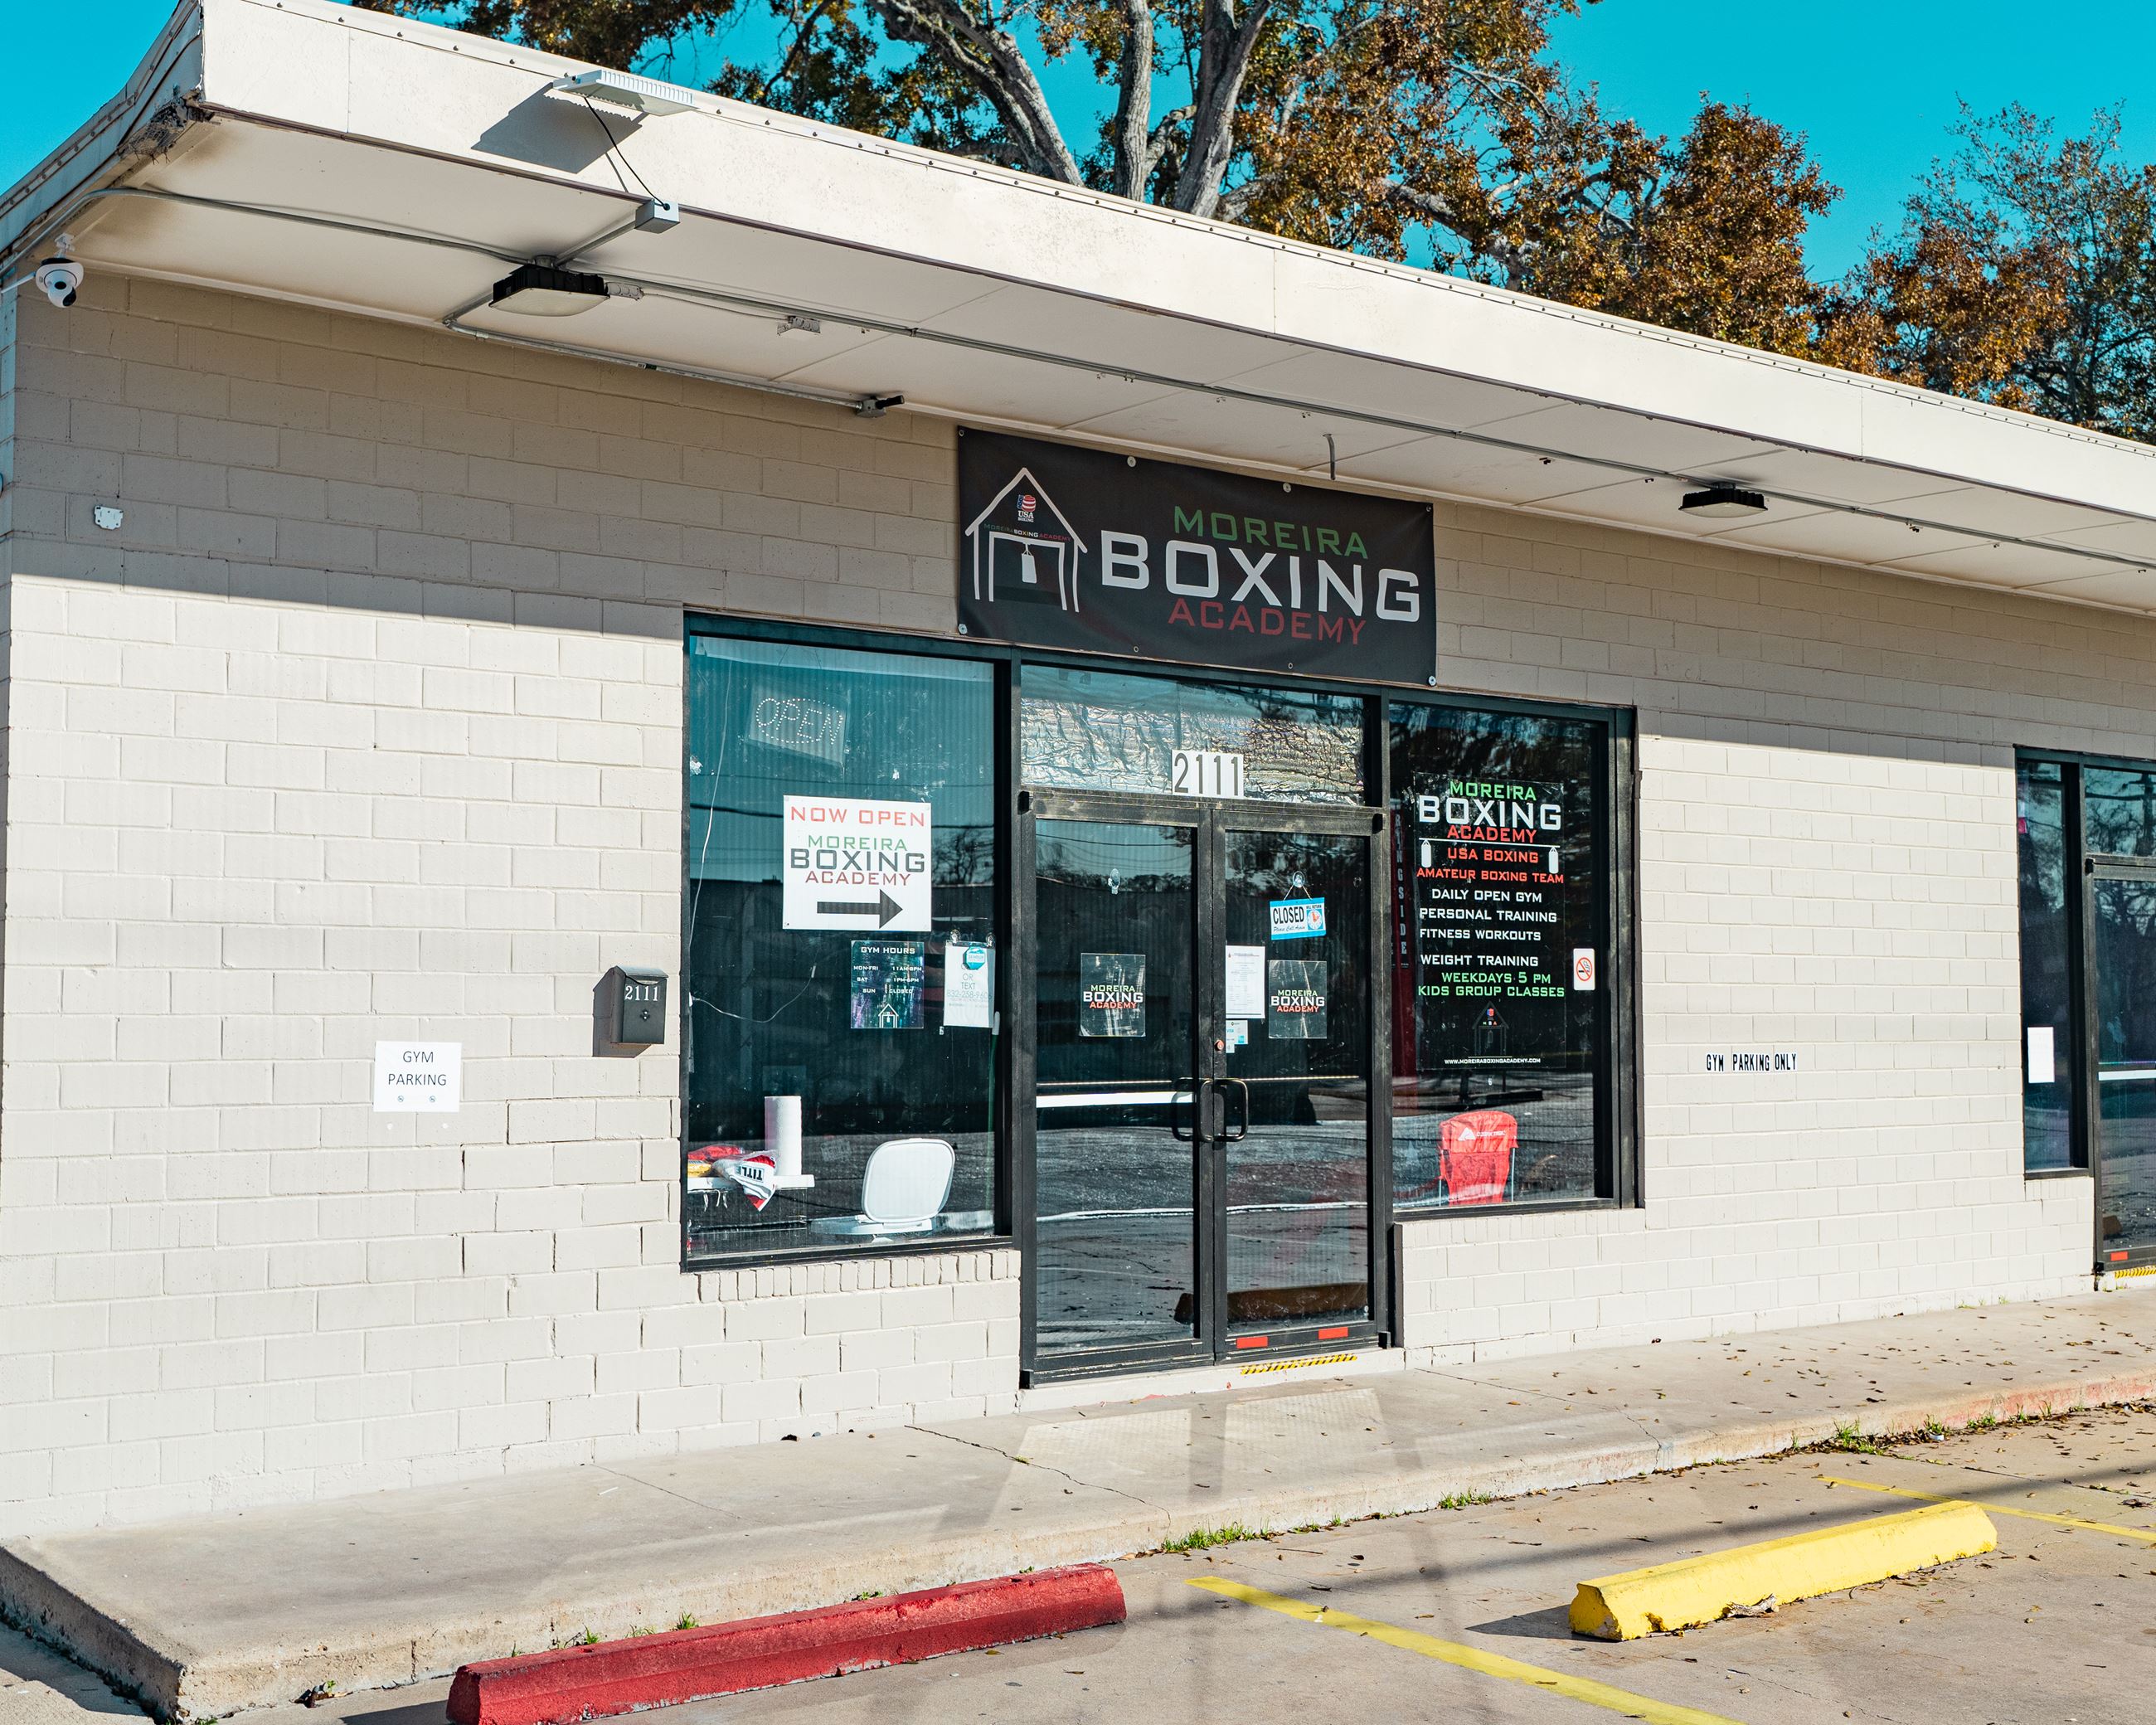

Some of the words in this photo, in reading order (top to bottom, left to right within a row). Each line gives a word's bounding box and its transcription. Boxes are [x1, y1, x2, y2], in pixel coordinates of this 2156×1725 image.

[1017, 510, 1034, 519] USA
[1173, 505, 1369, 559] MOREIRA
[1100, 529, 1420, 622] BOXING
[1168, 598, 1367, 645] ACADEMY
[755, 697, 843, 745] OPEN
[1173, 752, 1239, 795] 2111
[1449, 781, 1537, 801] MOREIRA
[791, 806, 847, 824] NOW
[858, 809, 925, 827] OPEN
[1419, 794, 1561, 830] BOXING
[1447, 824, 1537, 843] ACADEMY
[808, 834, 907, 851] MOREIRA
[790, 848, 925, 872] BOXING
[1448, 848, 1479, 860] USA
[1483, 850, 1539, 863] BOXING
[805, 870, 911, 887] ACADEMY
[1416, 867, 1476, 880] AMATEUR
[1481, 870, 1527, 882] BOXING
[1532, 872, 1565, 884] TEAM
[1432, 888, 1469, 900] DAILY
[1474, 890, 1510, 901] OPEN
[1516, 892, 1542, 903] GYM
[1273, 906, 1304, 925] CLOSED
[1419, 907, 1492, 921] PERSONAL
[1496, 910, 1557, 923] TRAINING
[1420, 928, 1470, 939] FITNESS
[1475, 930, 1542, 940] WORKOUTS
[1420, 955, 1472, 965] WEIGHT
[1477, 955, 1539, 967] TRAINING
[962, 973, 974, 981] OR
[1441, 972, 1512, 984] WEEKDAYS
[1517, 971, 1527, 984] 5
[1533, 974, 1551, 984] PM
[624, 984, 659, 1002] 2111
[961, 982, 976, 990] TEXT
[1418, 985, 1449, 996] KIDS
[1455, 985, 1502, 997] GROUP
[1507, 986, 1565, 998] CLASSES
[1083, 991, 1144, 1003] BOXING
[1089, 1001, 1137, 1009] ACADEMY
[1270, 996, 1325, 1007] BOXING
[402, 1051, 435, 1063] GYM
[1706, 1053, 1724, 1071] GYM
[1732, 1053, 1770, 1071] PARKING
[1775, 1053, 1797, 1071] ONLY
[388, 1073, 448, 1086] PARKING
